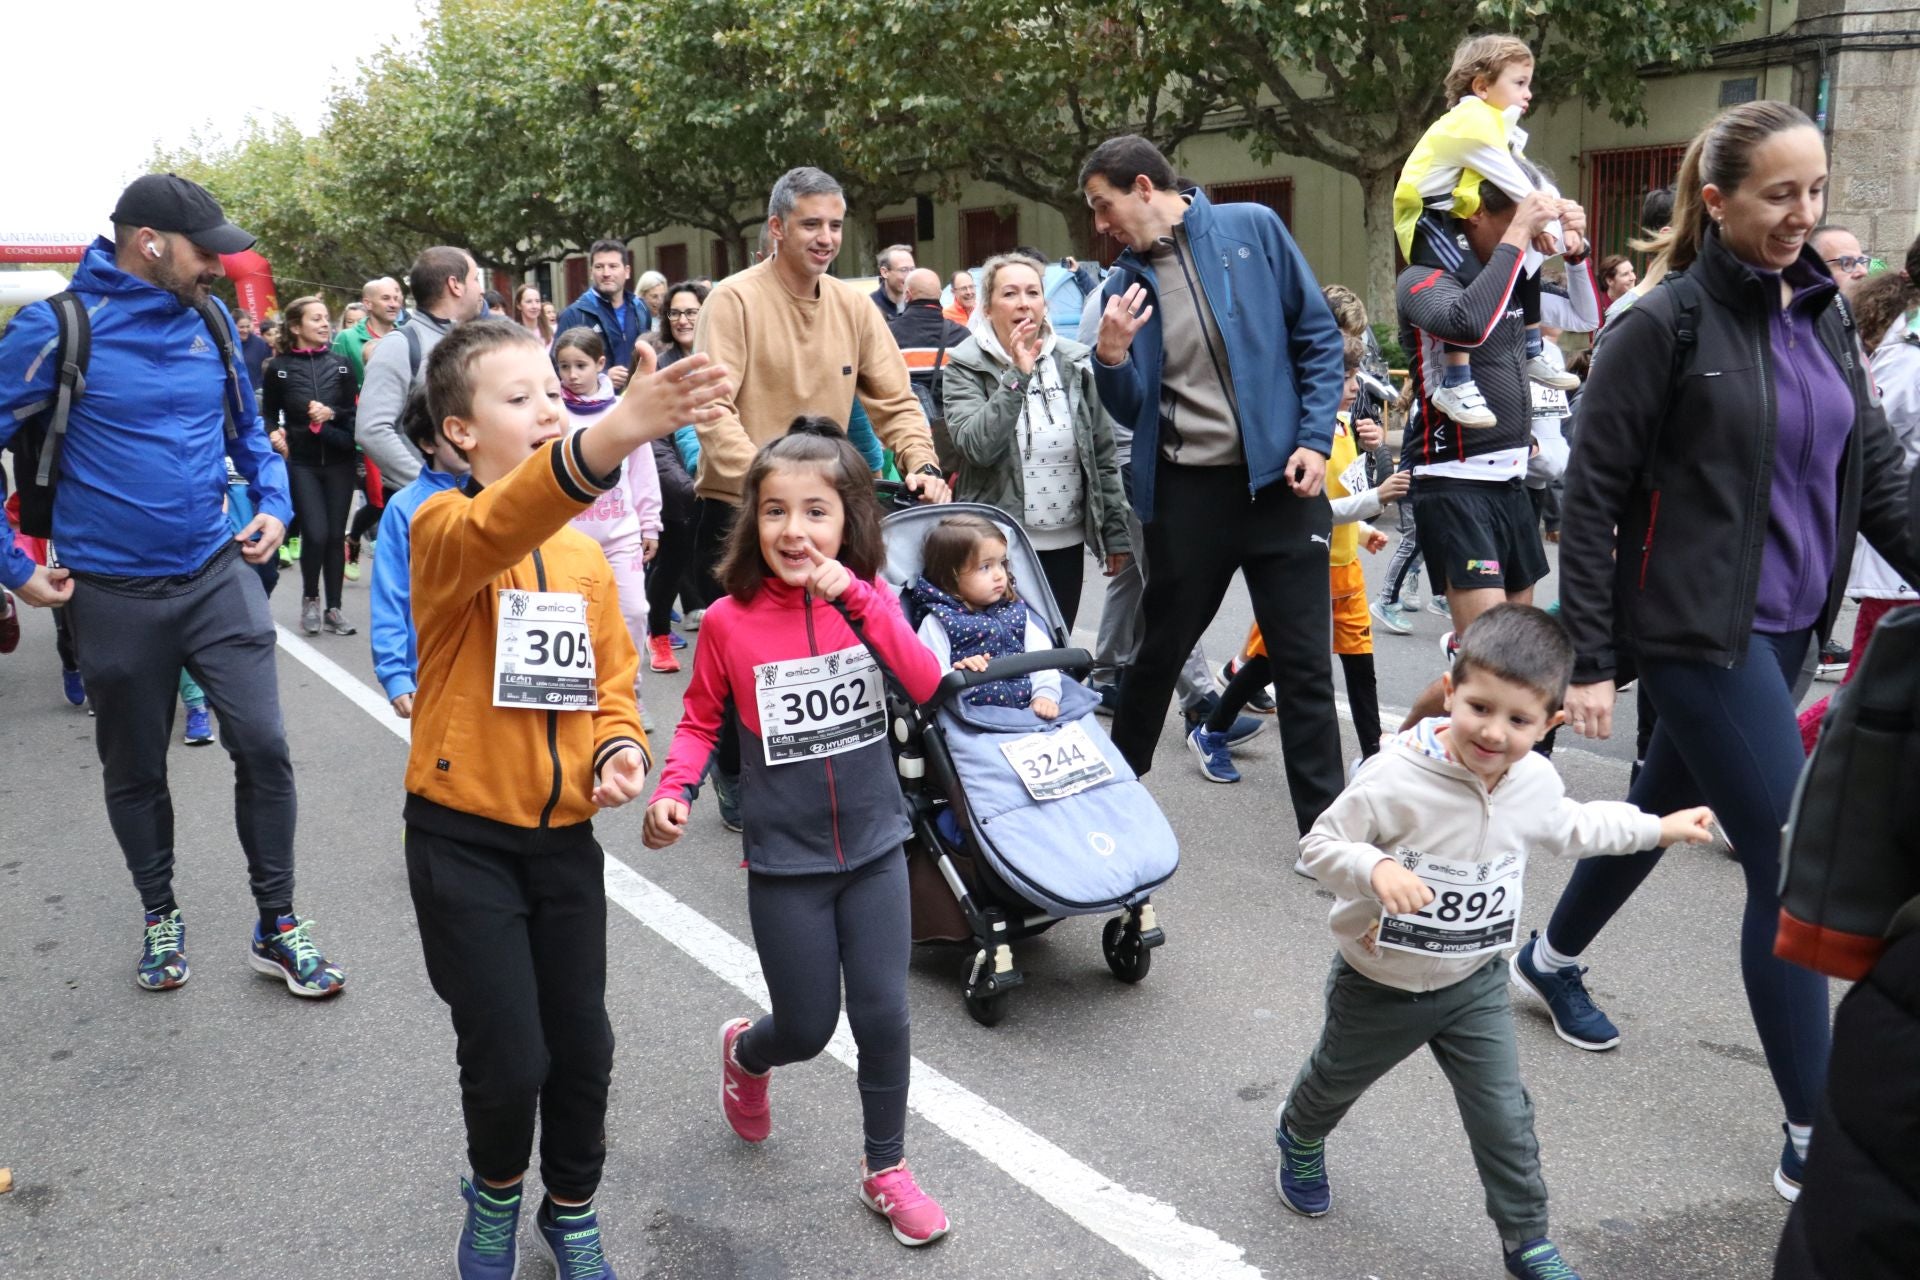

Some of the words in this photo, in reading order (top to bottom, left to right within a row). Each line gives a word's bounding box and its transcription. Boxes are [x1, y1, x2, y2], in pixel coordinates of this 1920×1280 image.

[536, 602, 576, 613] emico
[524, 629, 592, 669] 305
[785, 666, 820, 677] emico
[781, 678, 870, 726] 3062
[826, 735, 861, 750] HYUNDAI
[1022, 743, 1087, 780] 3244
[1428, 864, 1469, 878] emico
